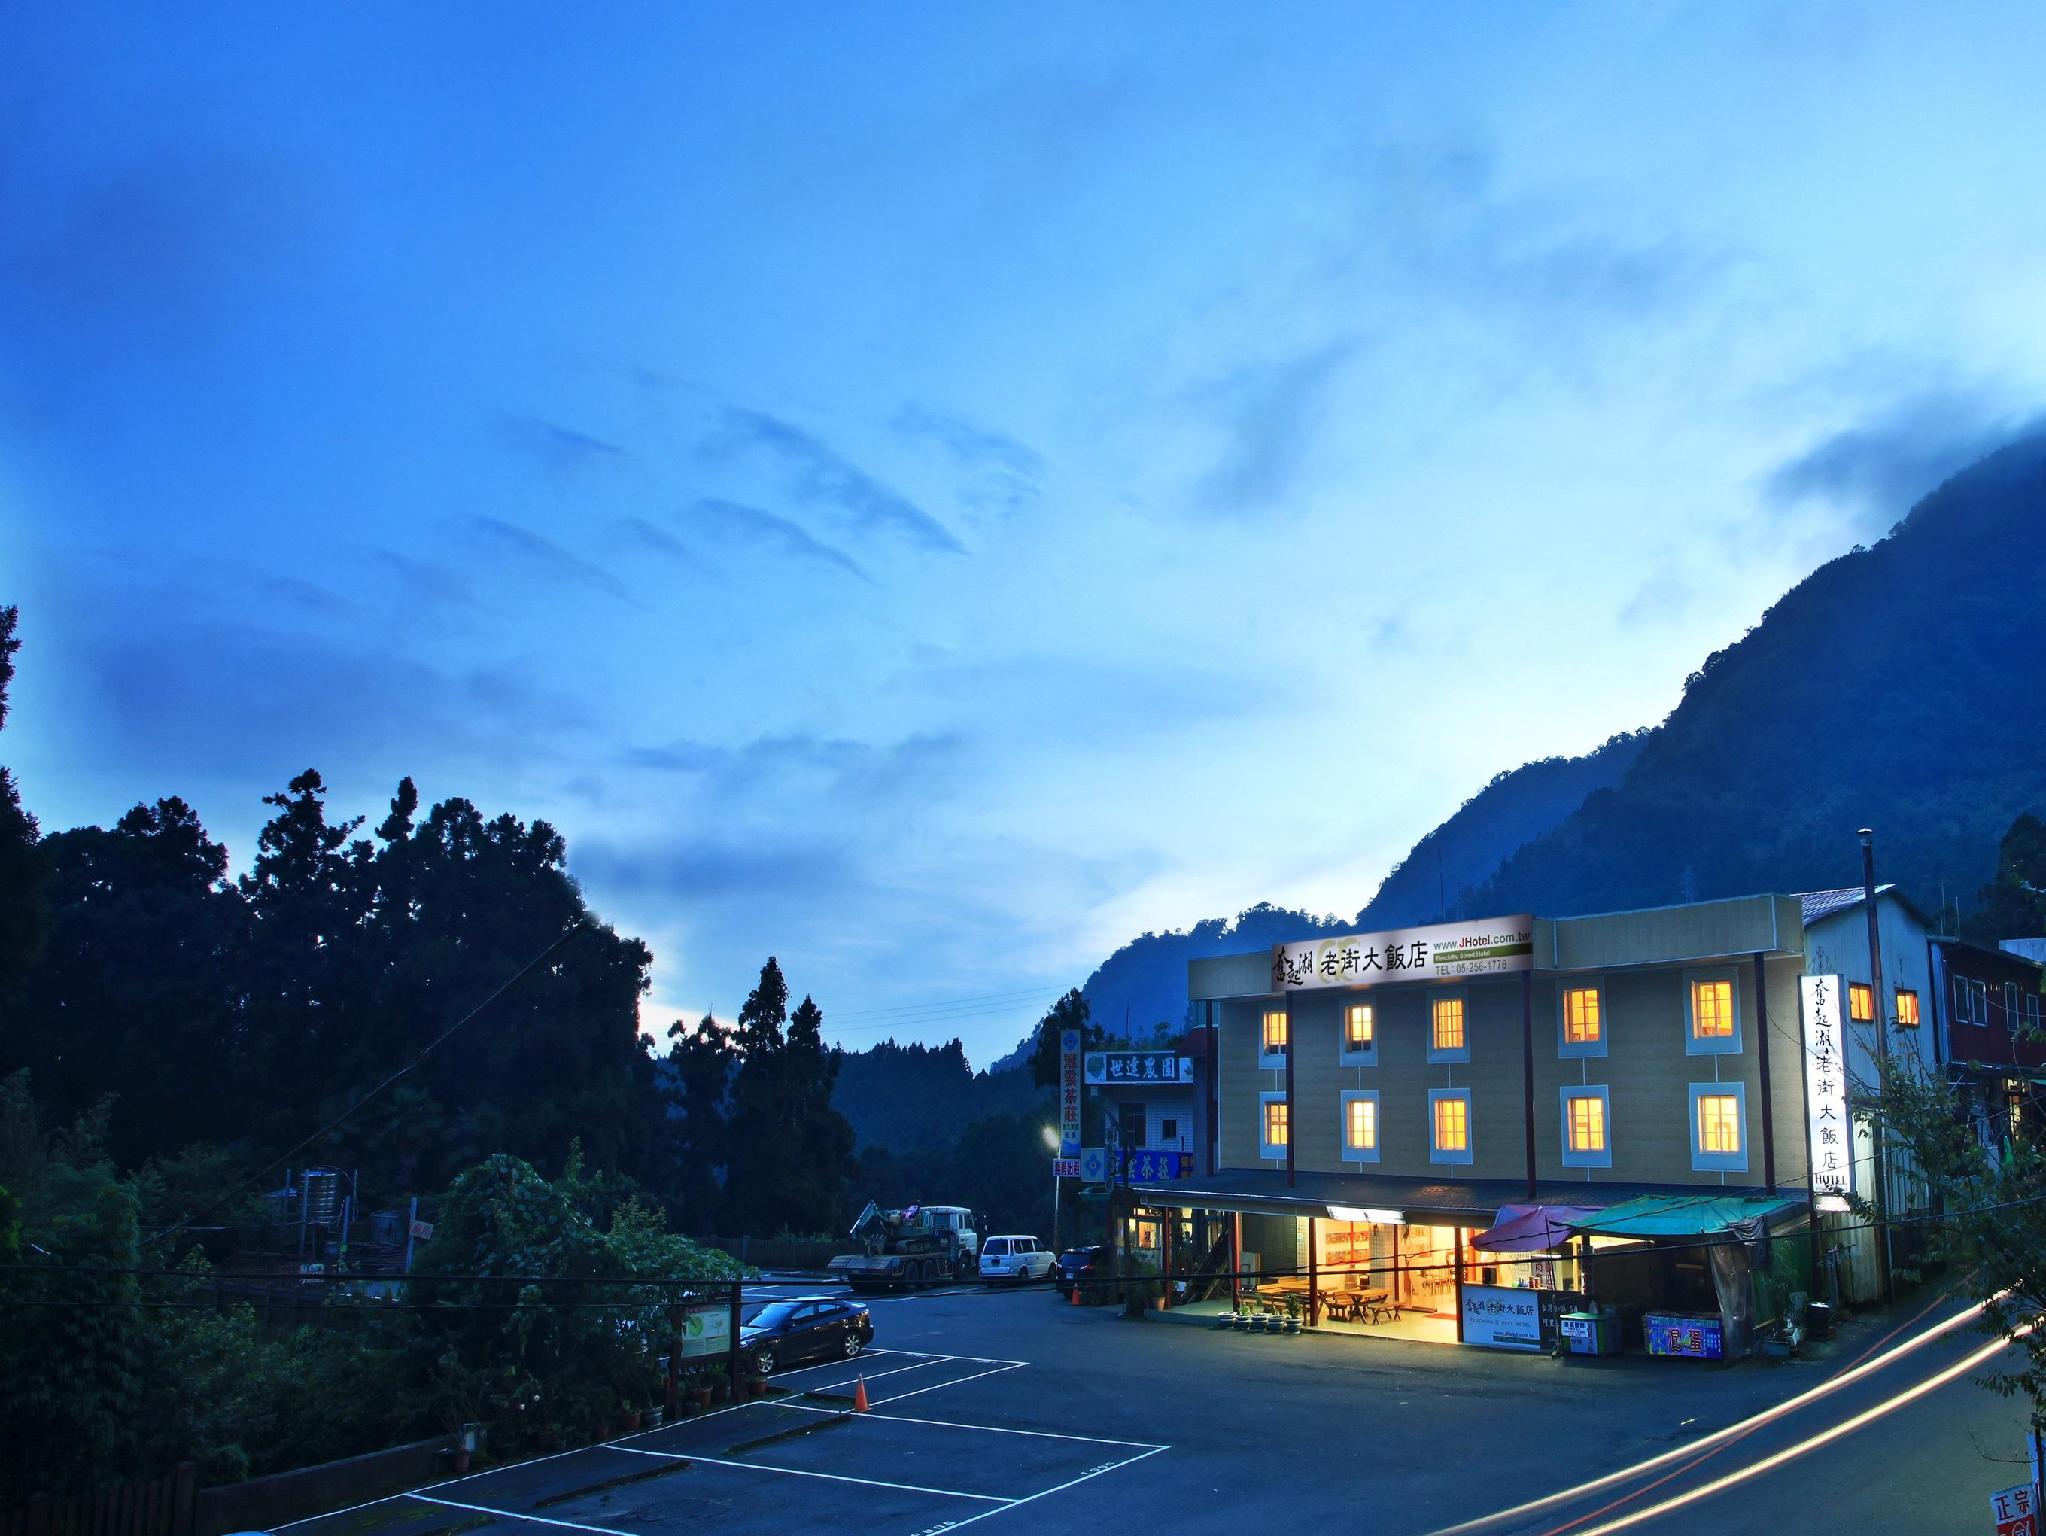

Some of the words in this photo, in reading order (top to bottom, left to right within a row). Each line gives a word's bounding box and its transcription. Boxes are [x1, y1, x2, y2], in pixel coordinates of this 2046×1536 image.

[1433, 931, 1530, 951] www.JHotel.com.tw
[1110, 1056, 1176, 1079] 世達農園
[1993, 1489, 2030, 1521] 正宗
